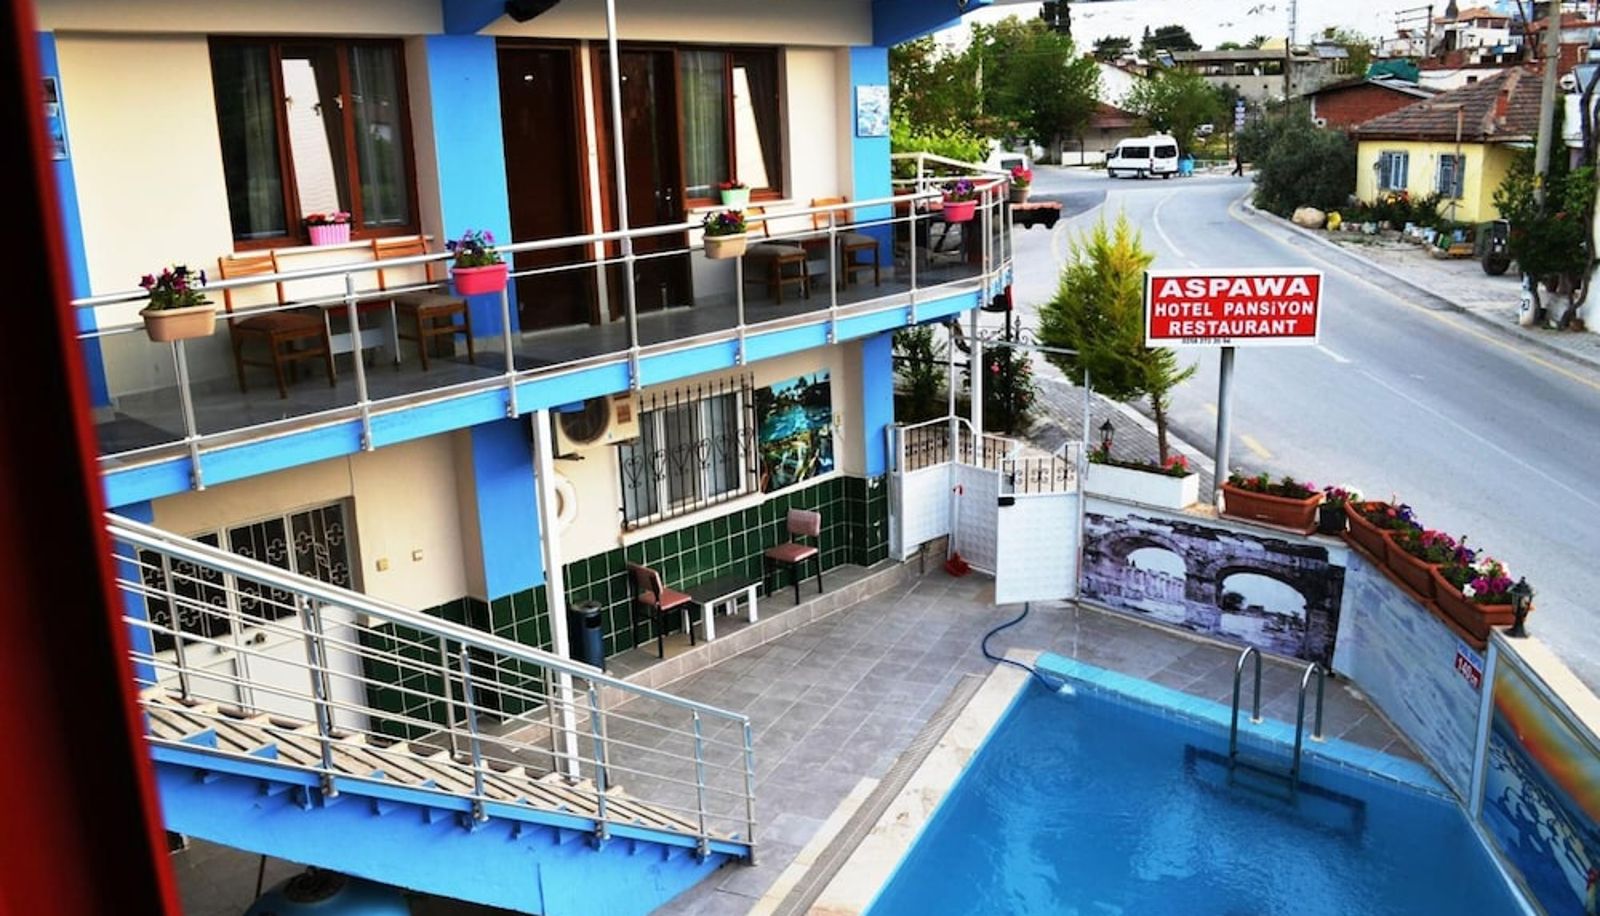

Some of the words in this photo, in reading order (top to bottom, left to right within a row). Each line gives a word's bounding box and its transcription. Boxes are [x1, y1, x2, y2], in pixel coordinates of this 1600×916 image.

[1159, 278, 1310, 298] ASPAWA
[1154, 302, 1213, 317] HOTEL
[1168, 319, 1298, 336] RESTAURANT
